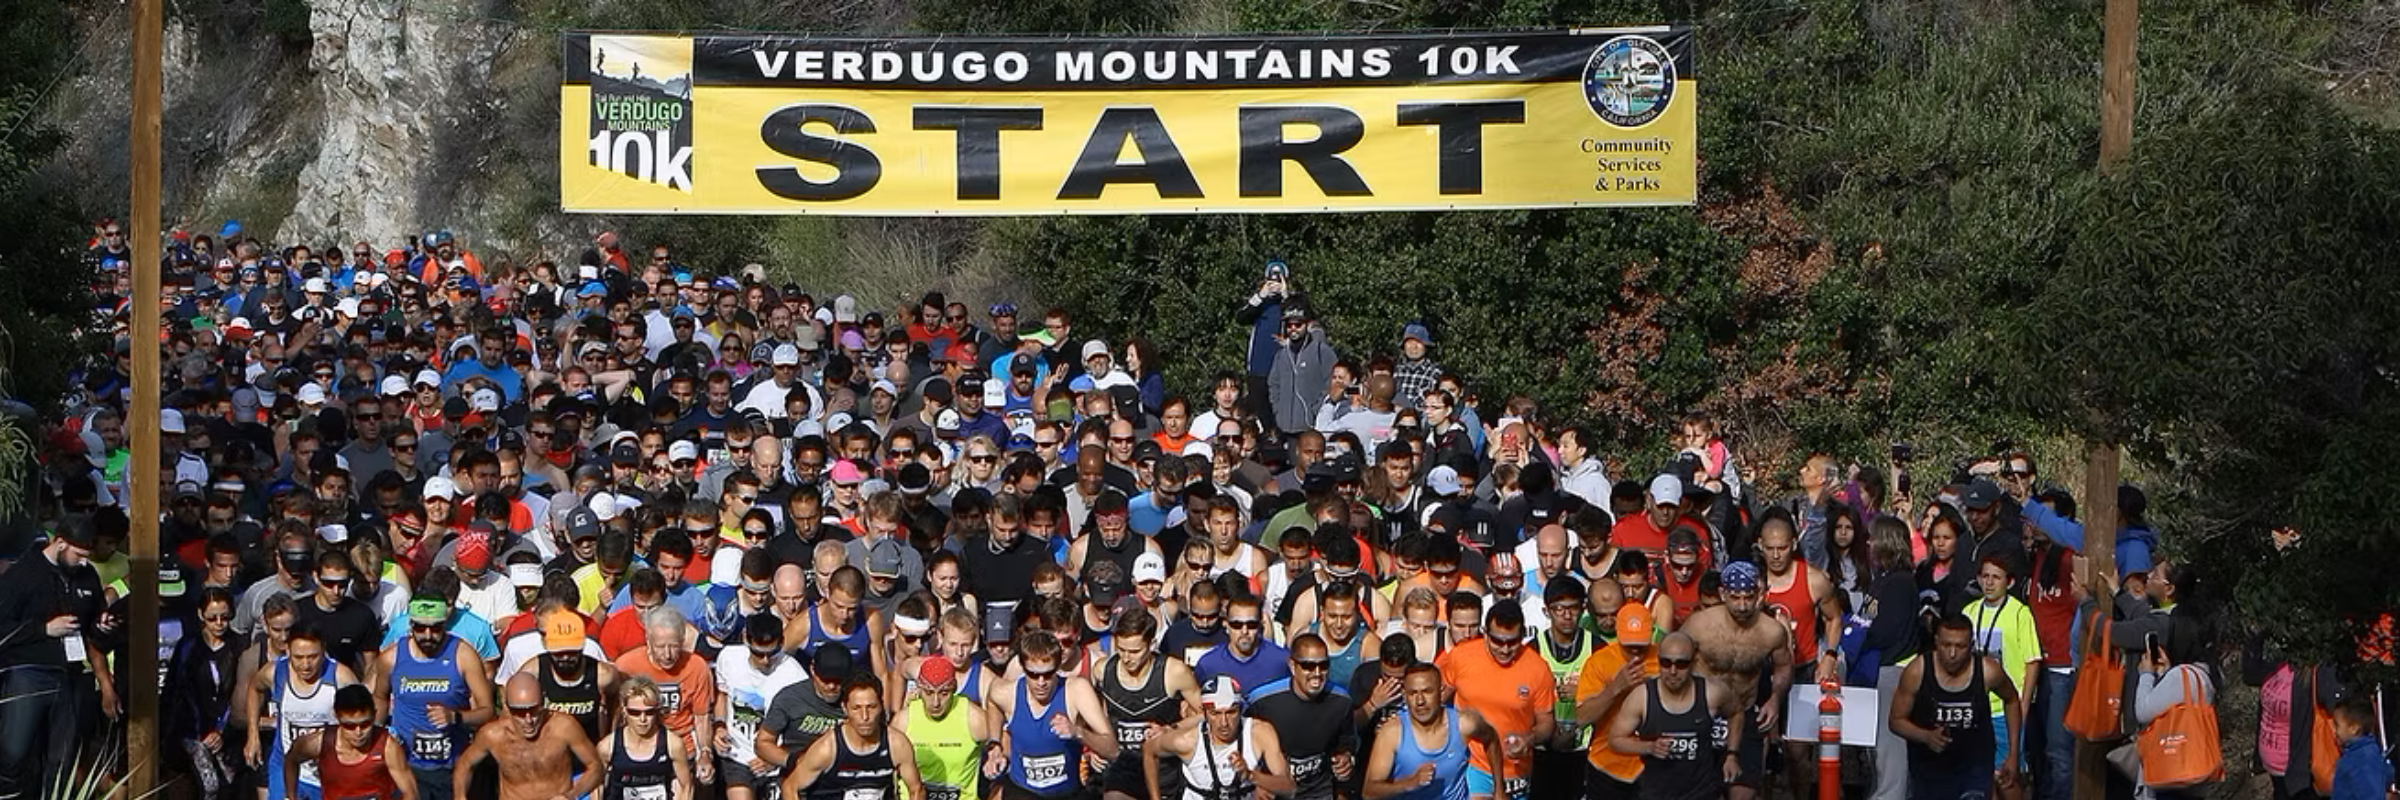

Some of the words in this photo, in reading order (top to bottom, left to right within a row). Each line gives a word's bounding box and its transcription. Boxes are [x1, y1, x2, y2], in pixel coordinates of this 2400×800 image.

[753, 50, 1029, 82] VERDUGO
[1055, 48, 1392, 82] MOUNTAINS
[1418, 45, 1521, 76] 10K
[596, 102, 682, 120] VERDUGO
[607, 120, 671, 131] MOUNTAINS
[754, 100, 1526, 202] START
[1581, 138, 1673, 155] Community
[1598, 157, 1661, 172] Services
[1594, 176, 1609, 191] &
[1615, 176, 1660, 191] Parks
[1936, 708, 1973, 722] 1133
[1026, 765, 1065, 780] 9507
